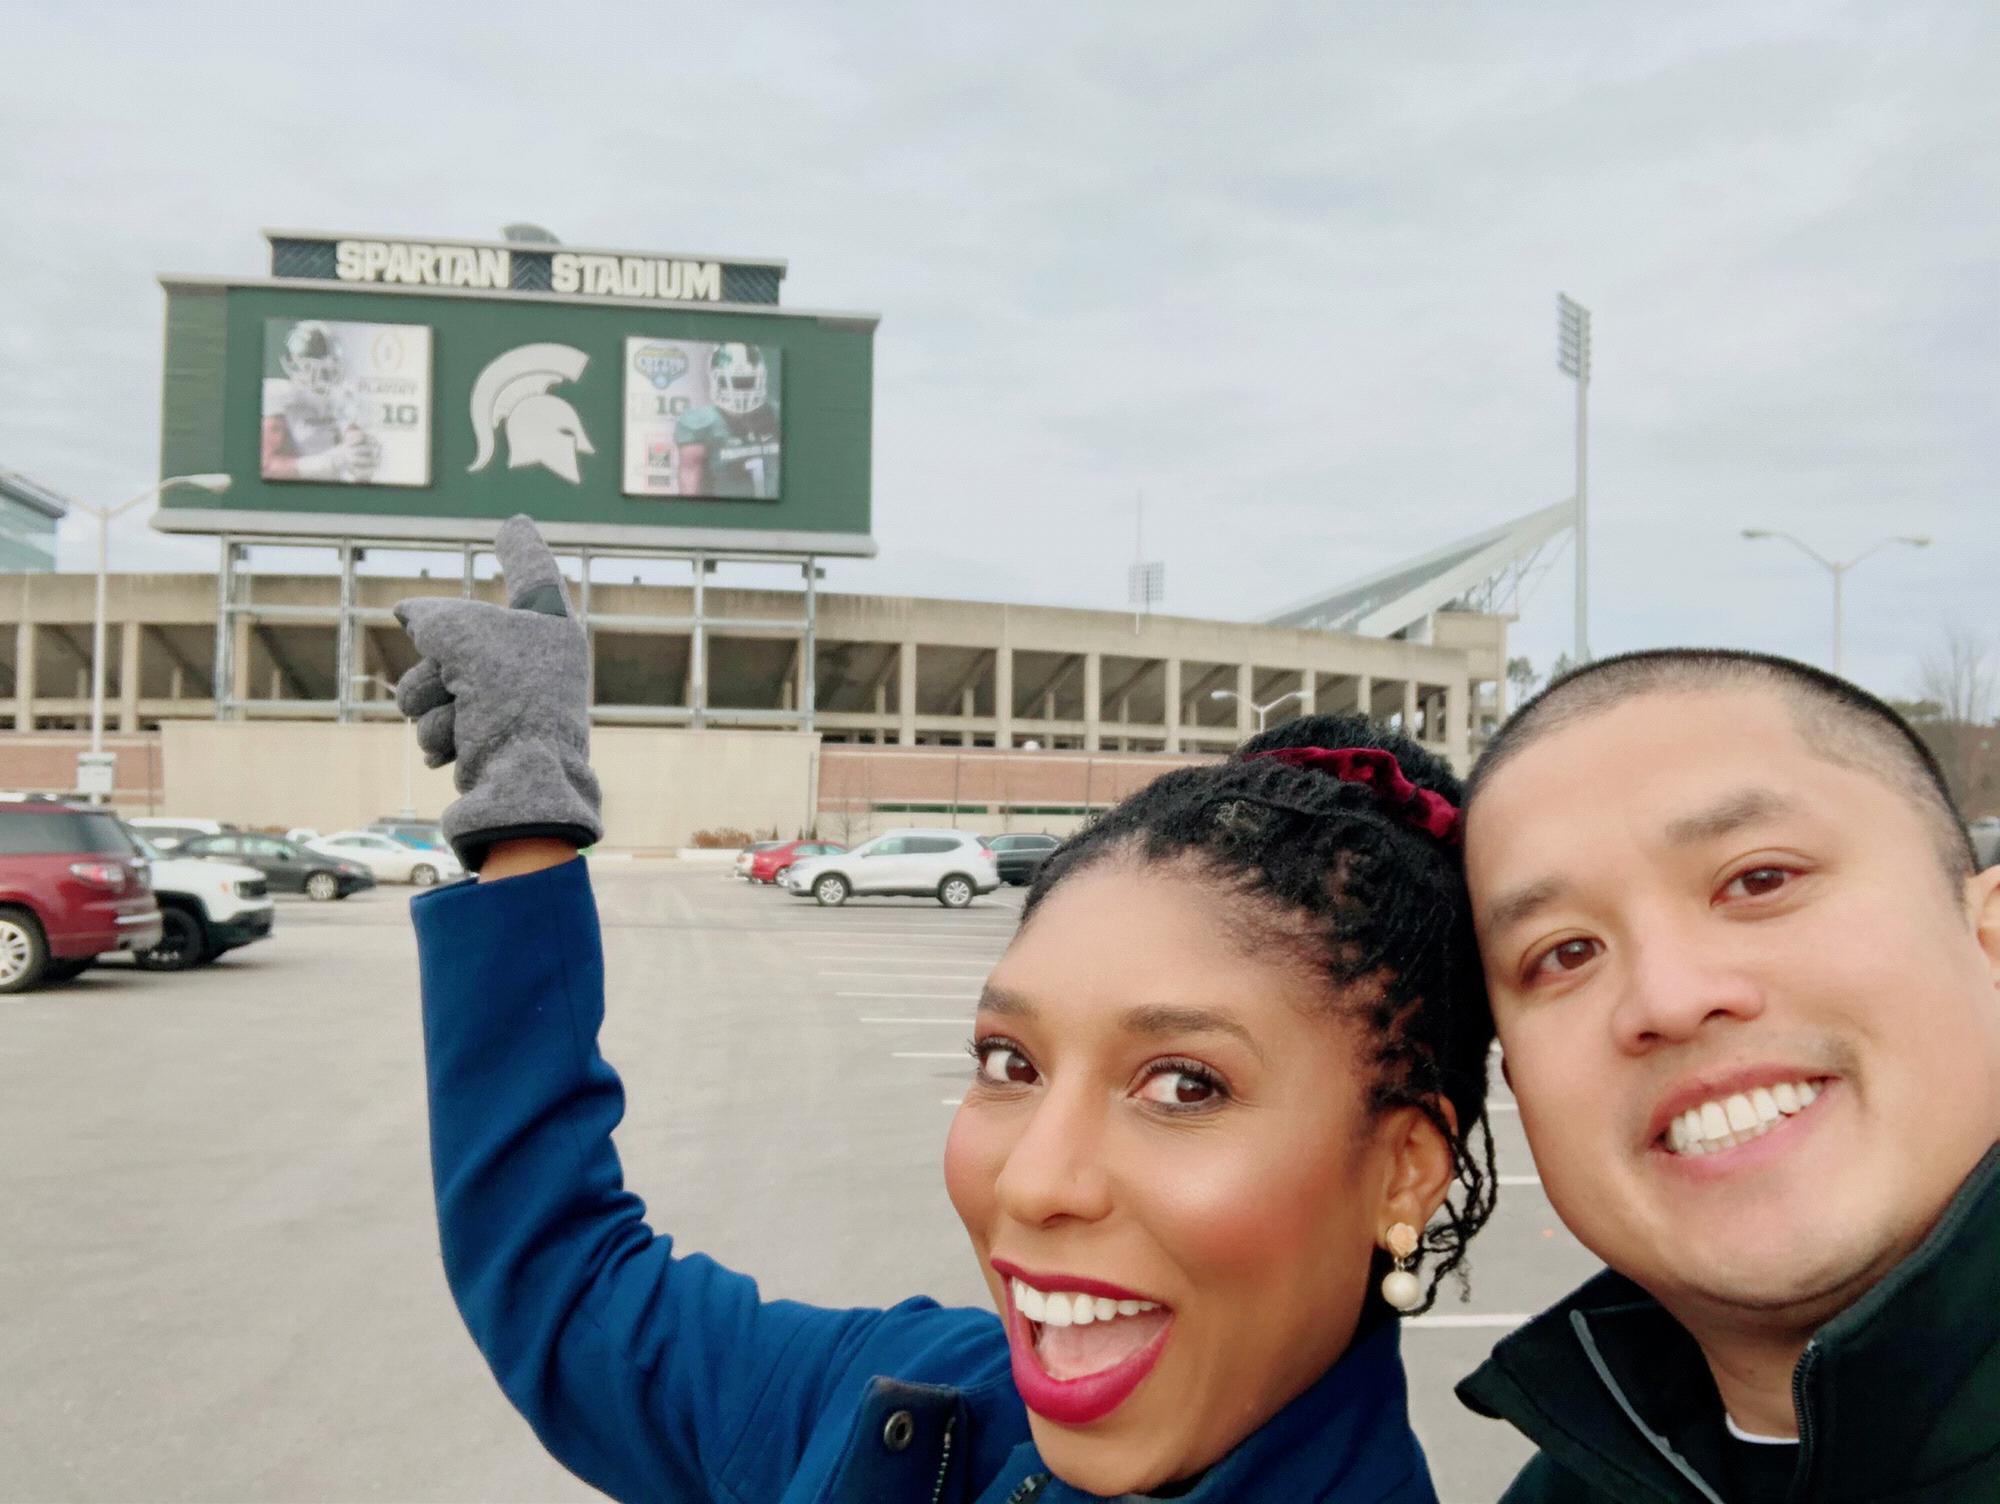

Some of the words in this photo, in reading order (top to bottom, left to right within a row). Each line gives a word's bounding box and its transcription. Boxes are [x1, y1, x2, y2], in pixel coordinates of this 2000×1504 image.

[335, 240, 511, 289] SPARTAN
[551, 253, 721, 301] STADIUM
[382, 403, 418, 425] 10
